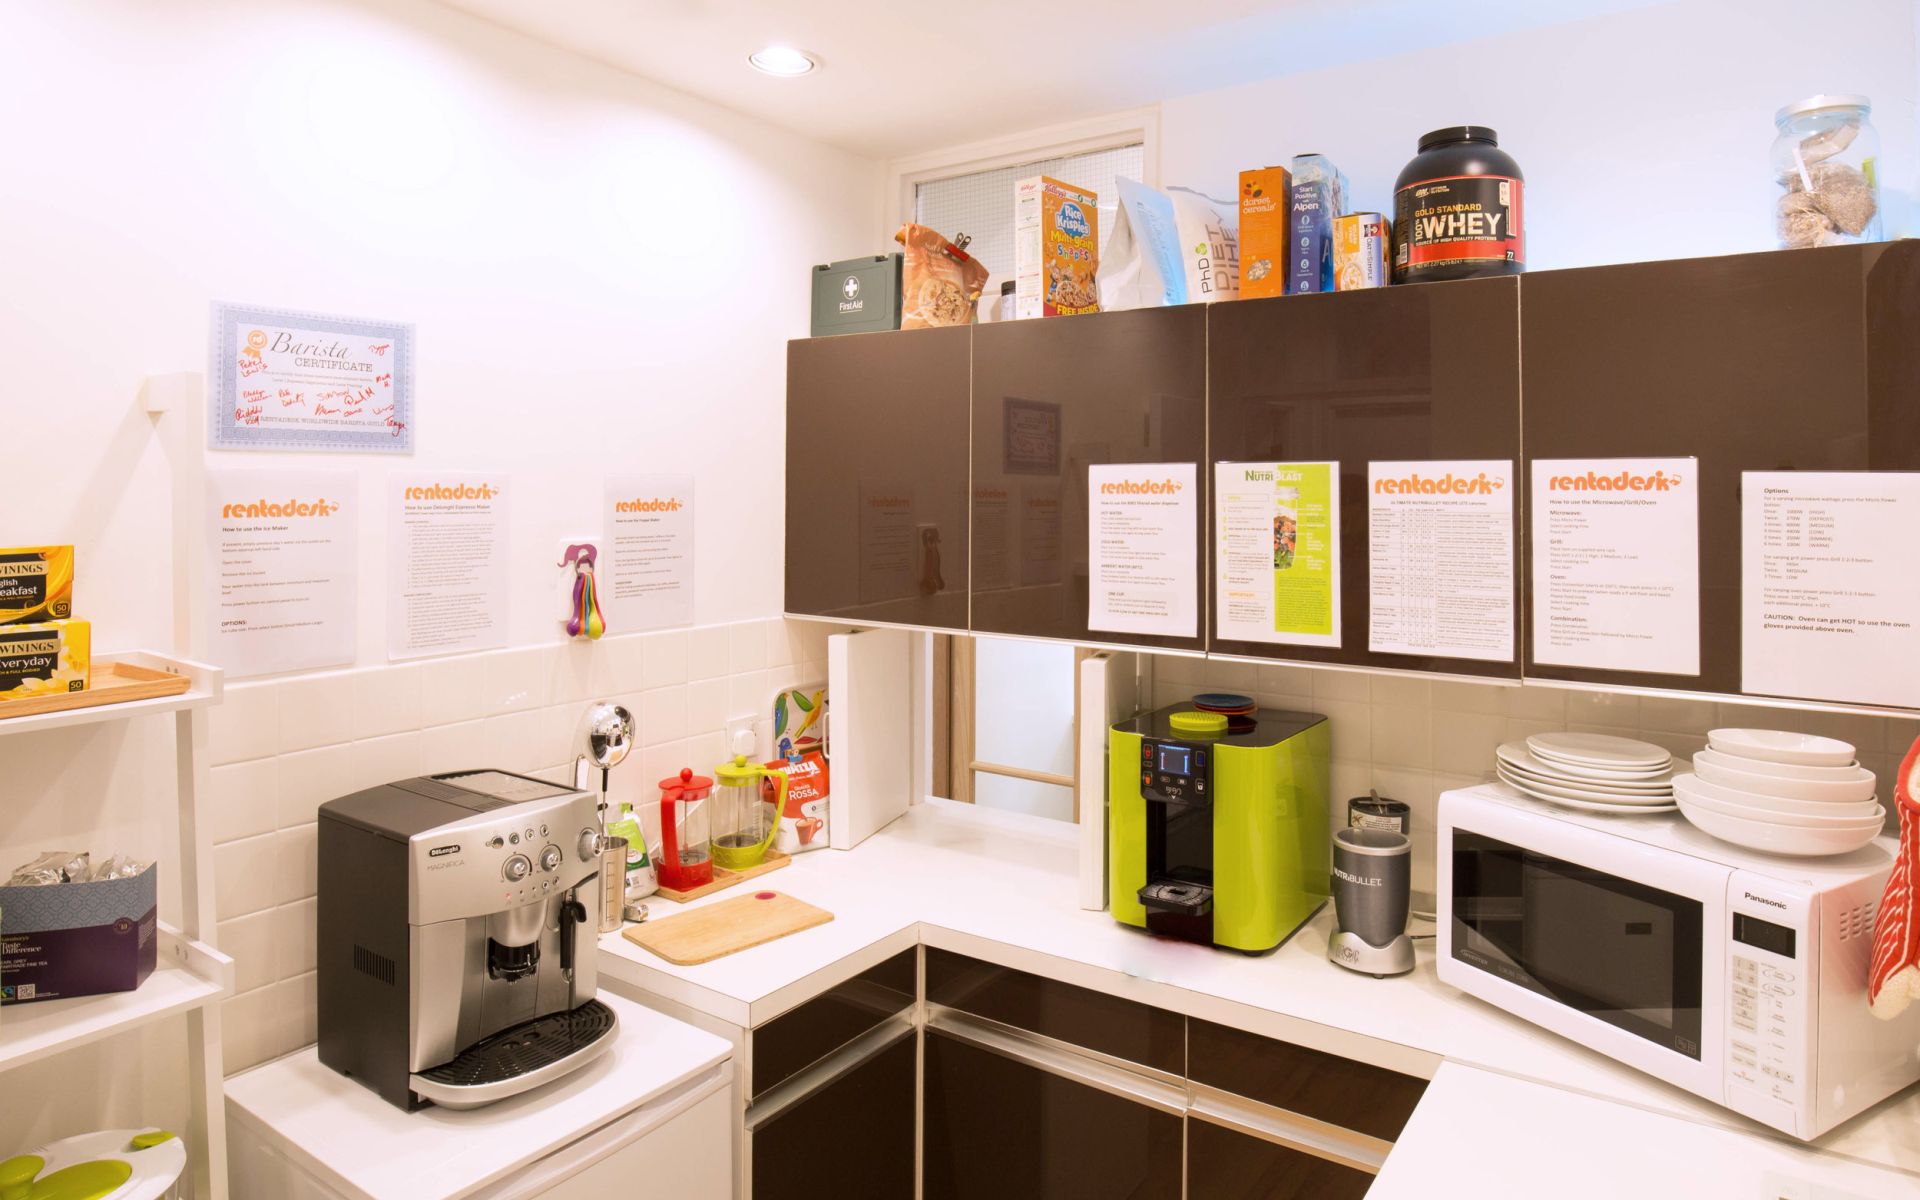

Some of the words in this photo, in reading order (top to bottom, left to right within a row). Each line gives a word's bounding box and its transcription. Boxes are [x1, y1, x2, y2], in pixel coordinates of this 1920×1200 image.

[1243, 198, 1270, 206] dorset
[1293, 202, 1319, 211] Alpen
[1064, 204, 1082, 221] Rice
[1415, 208, 1434, 217] GOLD
[1437, 203, 1481, 214] STANDARD
[1056, 213, 1089, 235] Krispies
[1415, 218, 1423, 241] 100%
[1423, 213, 1501, 239] WHEY
[1205, 223, 1230, 292] DIET
[1198, 257, 1212, 293] PhD
[1056, 304, 1077, 315] FREE
[270, 330, 352, 360] Barista
[294, 358, 374, 373] CERTIFICATE
[1101, 480, 1175, 495] rentadesk
[1375, 473, 1493, 494] rentadesk
[1550, 471, 1670, 491] rentadesk
[405, 483, 492, 500] rentadesk
[223, 498, 330, 518] rentadesk
[616, 498, 679, 512] rentadesk
[0, 564, 42, 575] ININGS
[0, 579, 18, 588] glish
[0, 586, 37, 596] eakfast
[1764, 622, 1783, 630] gloves
[1785, 623, 1813, 632] provided
[1830, 617, 1840, 625] get
[0, 642, 54, 654] WININGS
[71, 681, 82, 689] 50
[789, 788, 819, 800] ROSSA
[1744, 892, 1787, 910] Panasonic
